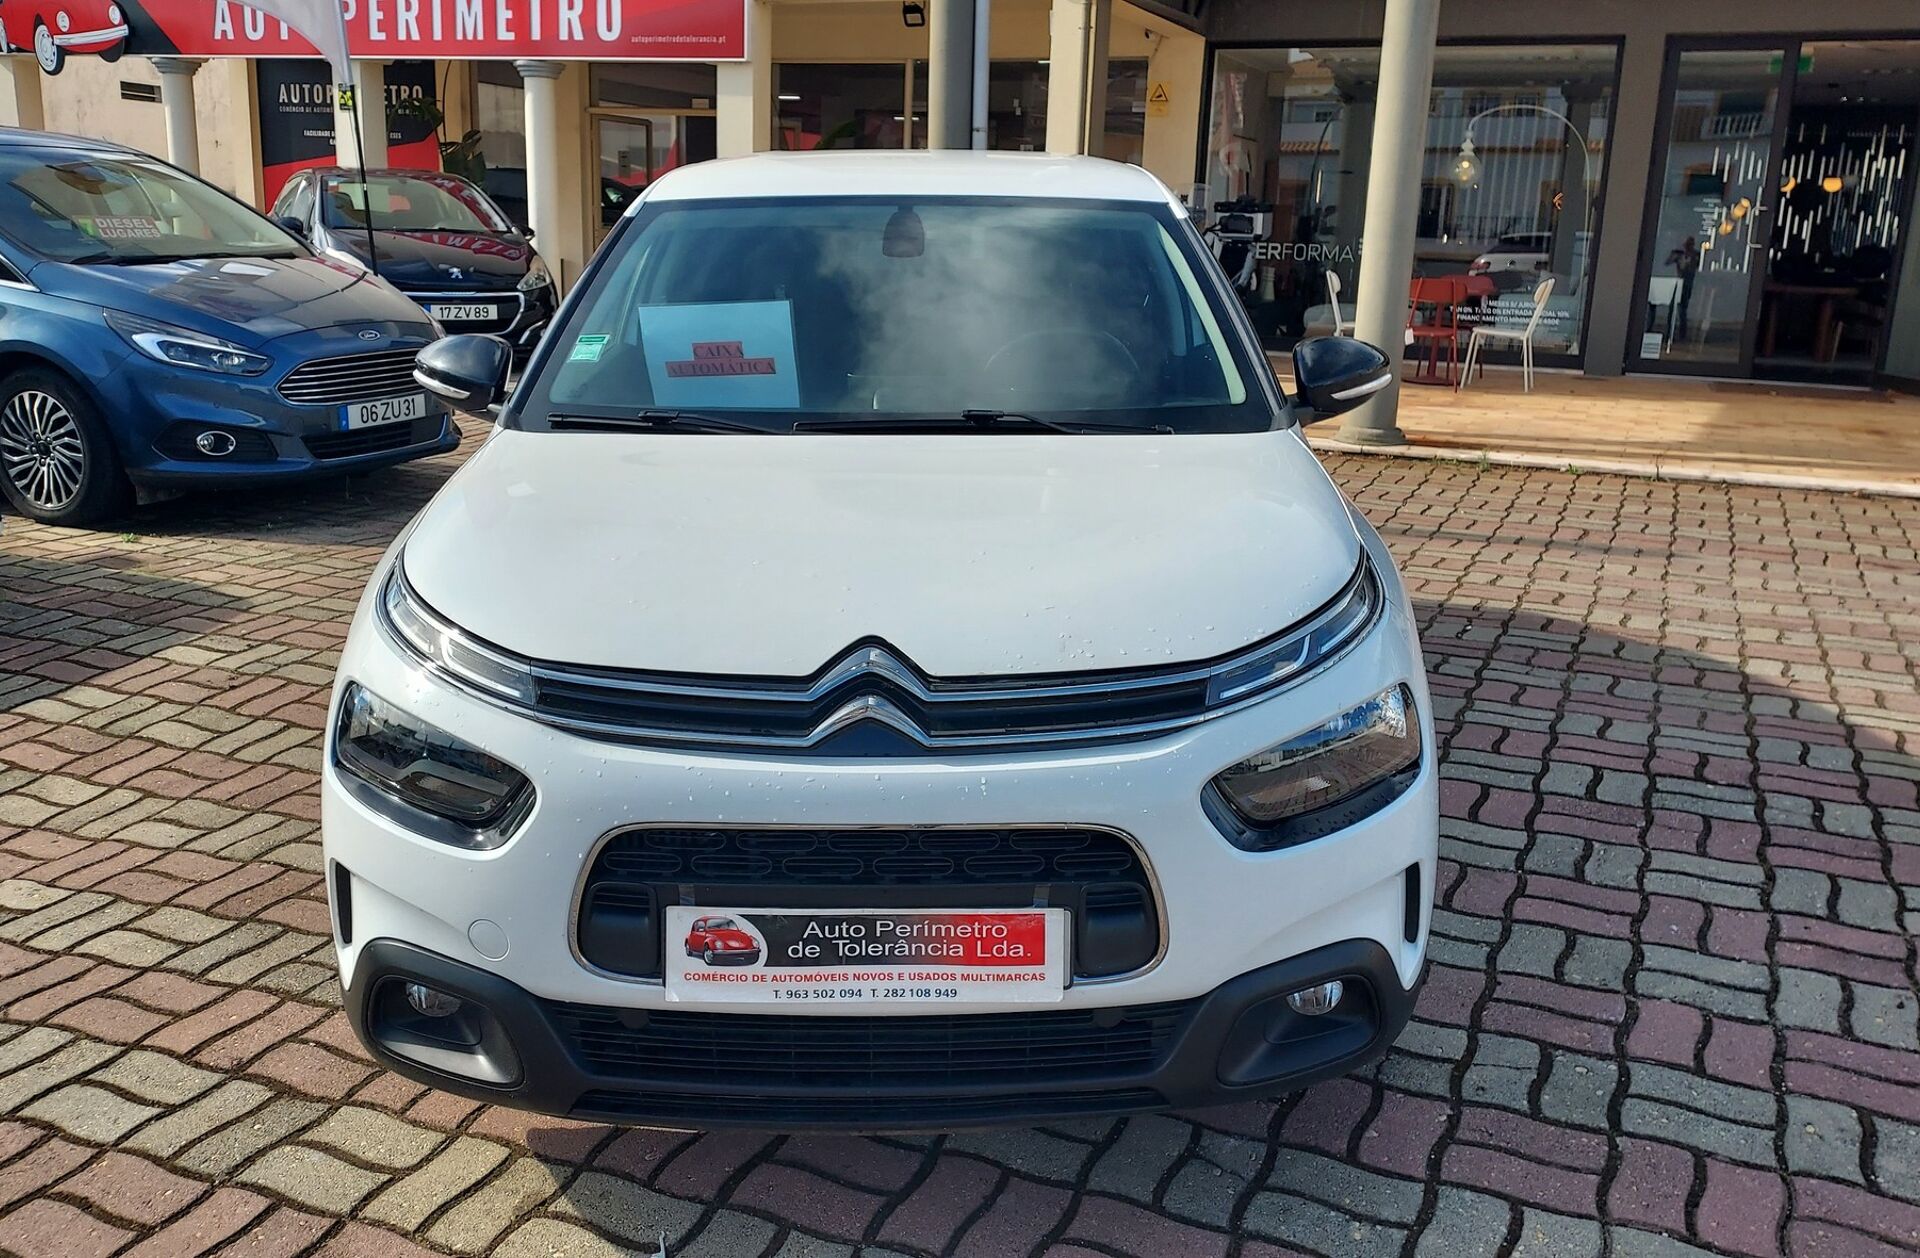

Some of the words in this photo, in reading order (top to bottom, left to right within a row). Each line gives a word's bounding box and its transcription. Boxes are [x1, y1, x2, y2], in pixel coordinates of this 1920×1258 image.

[95, 218, 153, 228] DIESEL
[99, 228, 160, 238] LUGARES
[693, 344, 744, 358] CAIXA
[803, 921, 865, 938] Auto
[875, 920, 1008, 938] Perímetro
[787, 941, 821, 958] de
[832, 939, 964, 957] Tolerância
[976, 939, 1032, 958] Lda.
[684, 971, 748, 982] COMÉRCIO
[752, 973, 768, 982] DE
[771, 971, 849, 982] AUTOMÓVEIS
[852, 972, 894, 982] NOVOS
[898, 972, 905, 981] E
[908, 972, 957, 982] USADOS
[961, 972, 1046, 982] MULTIMARCAS
[773, 989, 782, 999] T.
[786, 989, 809, 999] 963
[812, 989, 835, 998] 502
[839, 988, 862, 998] 094
[870, 988, 879, 998] T.
[883, 988, 906, 998] 282
[908, 988, 931, 998] 108
[934, 987, 958, 998] 949
